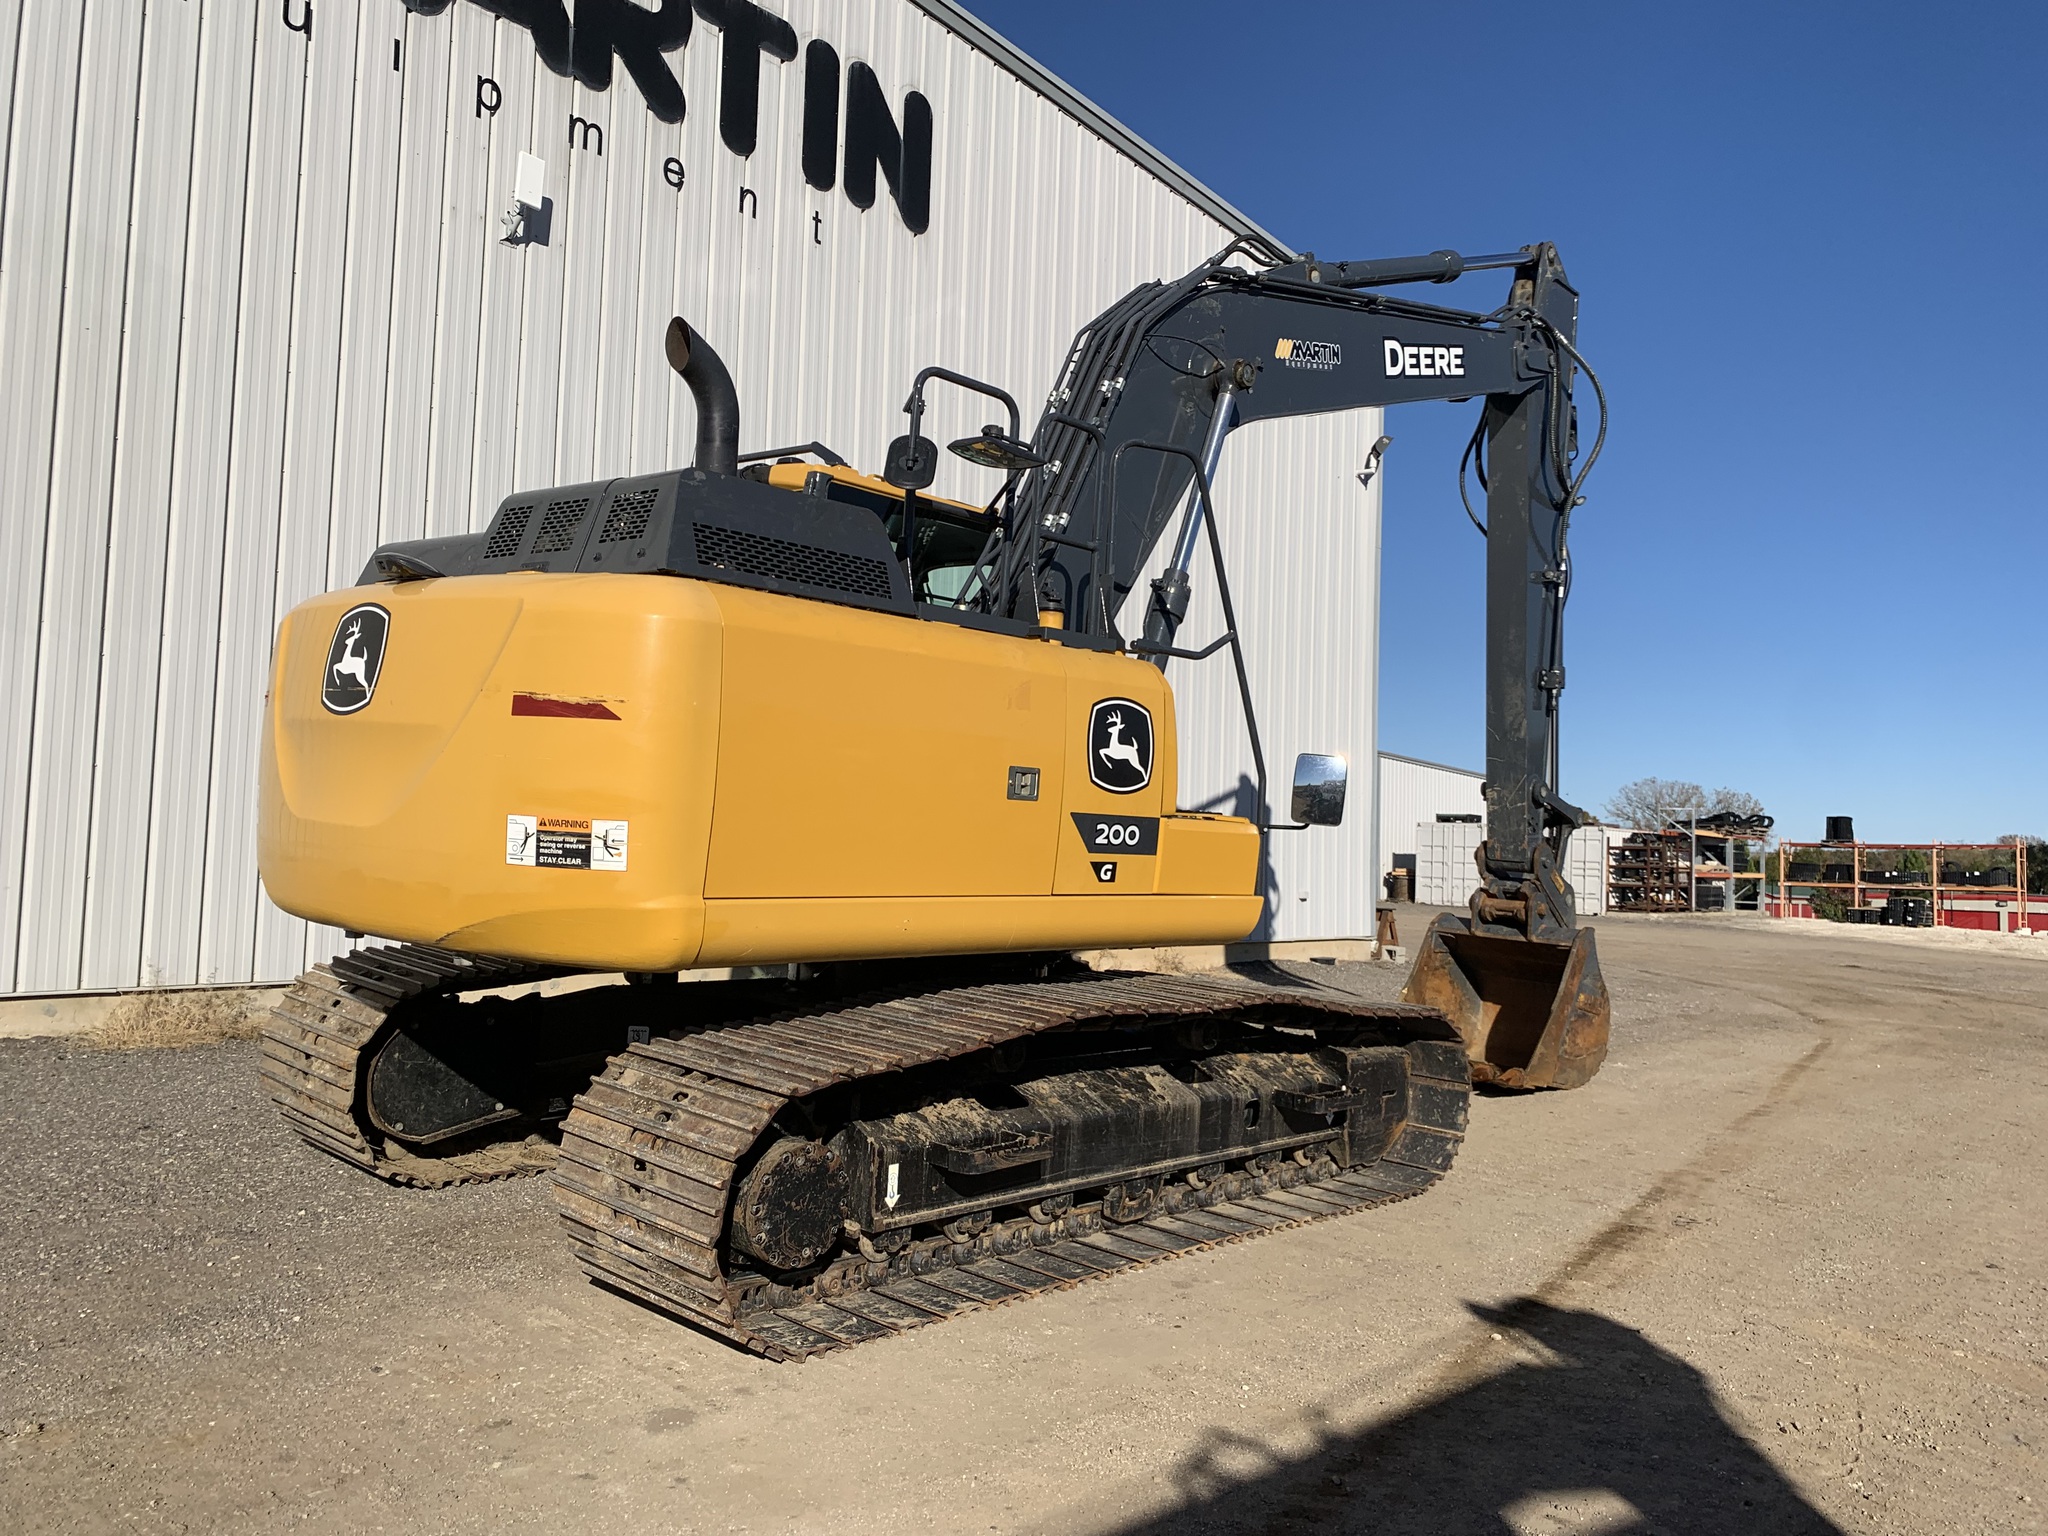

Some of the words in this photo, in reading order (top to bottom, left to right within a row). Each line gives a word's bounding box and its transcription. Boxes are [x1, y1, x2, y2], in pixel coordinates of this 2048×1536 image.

[1290, 340, 1341, 364] MARTIN
[1383, 339, 1465, 376] DEERE
[547, 819, 589, 829] WARNING
[1094, 823, 1140, 846] 200
[539, 856, 557, 864] STAY
[557, 857, 582, 865] CLEAR
[1101, 864, 1113, 881] G
